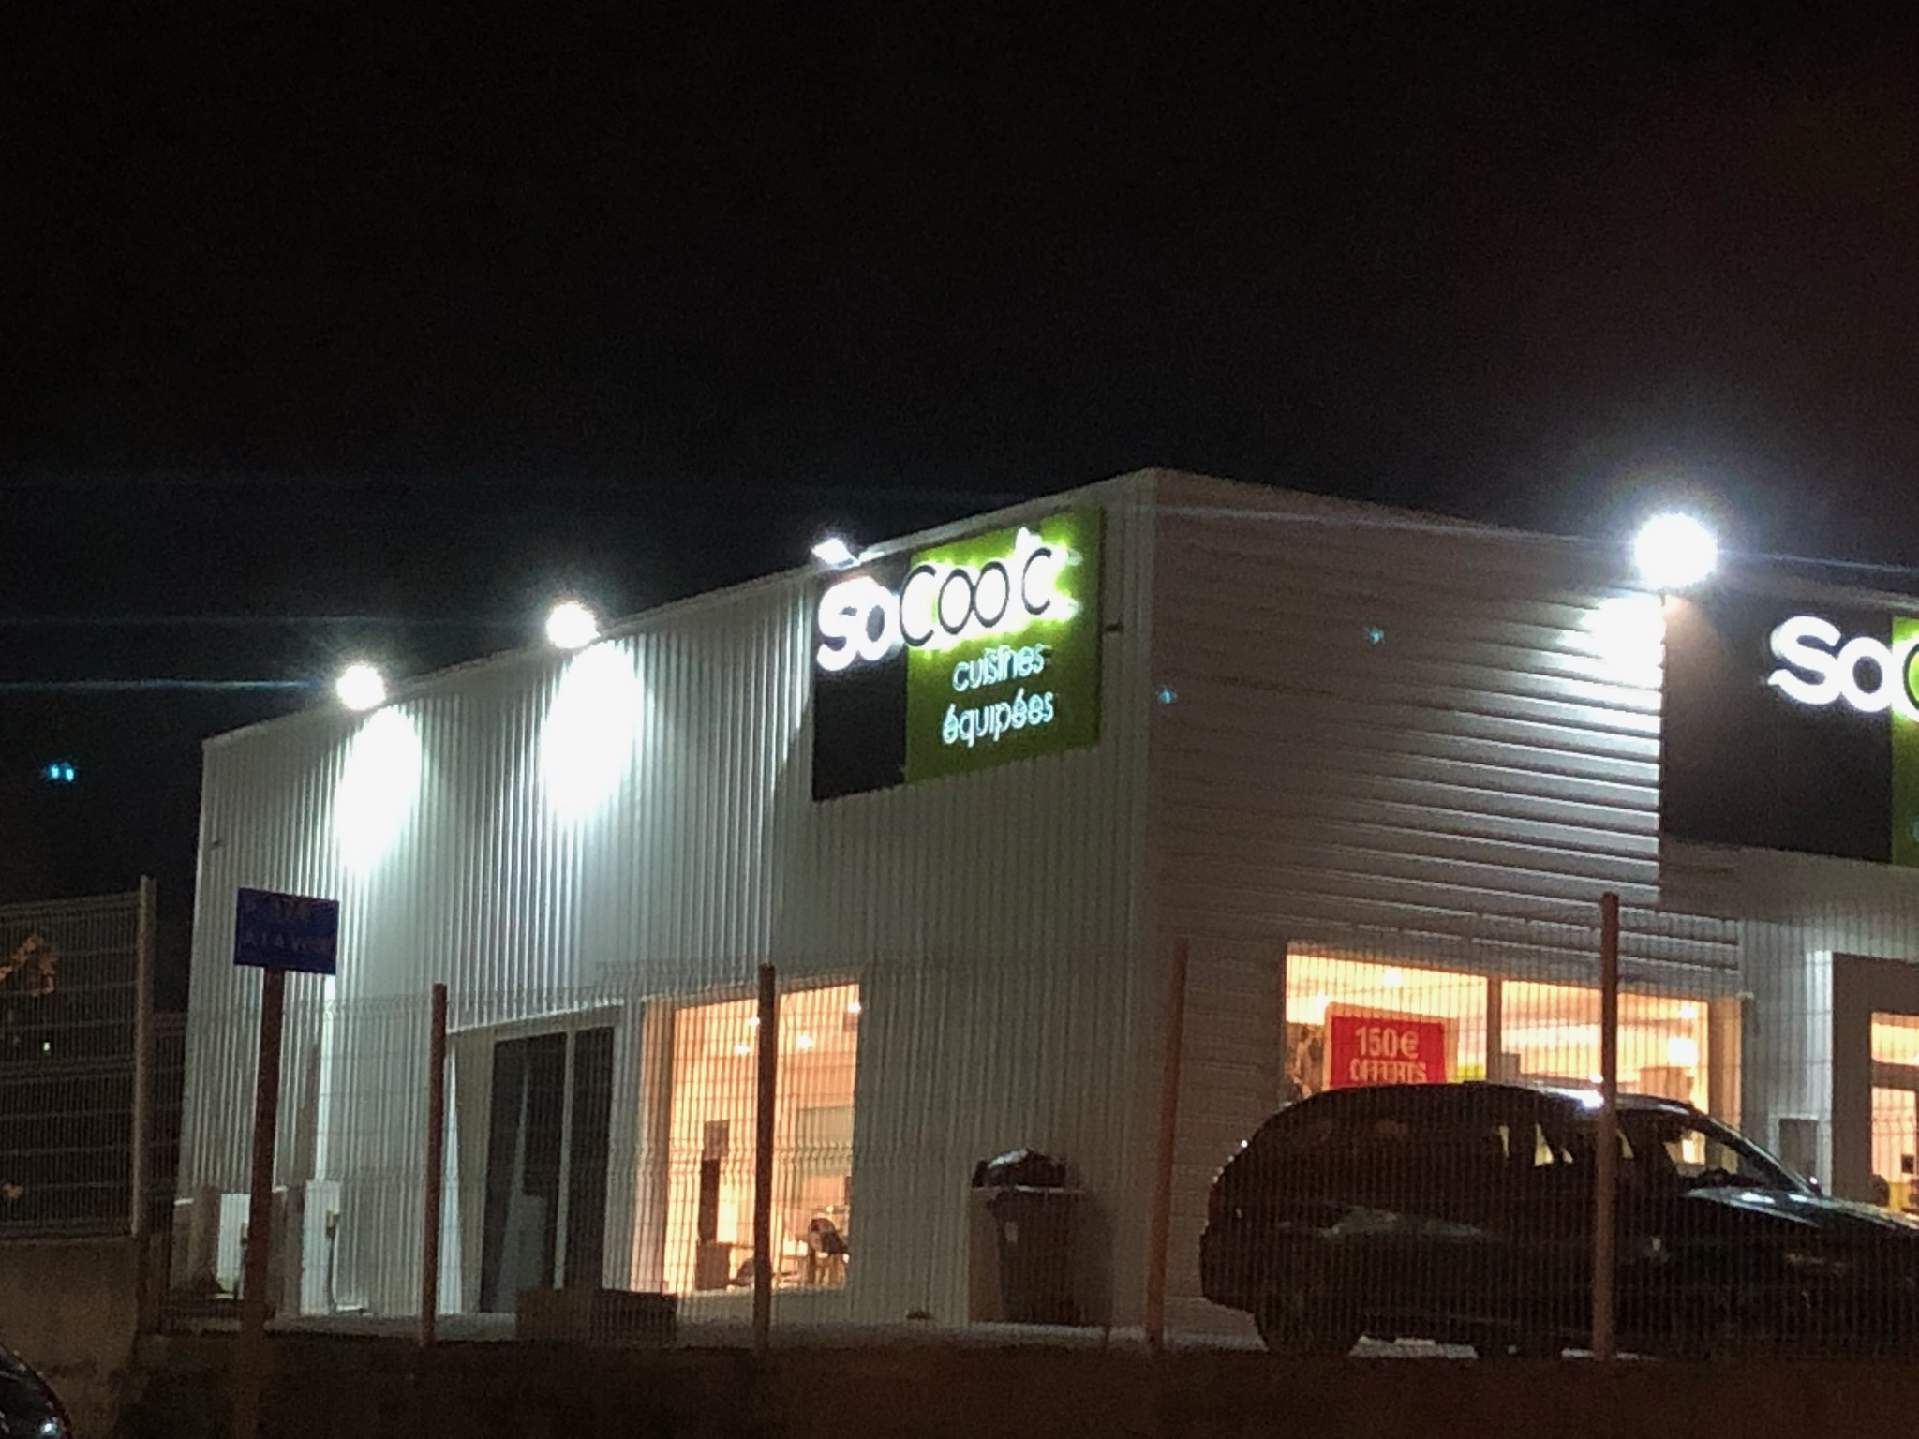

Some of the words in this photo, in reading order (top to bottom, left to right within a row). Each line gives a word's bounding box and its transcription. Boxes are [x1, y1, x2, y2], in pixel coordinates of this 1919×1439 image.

[952, 643, 1047, 691] cuisines
[943, 688, 1055, 748] équipées
[1355, 1026, 1420, 1060] 150€
